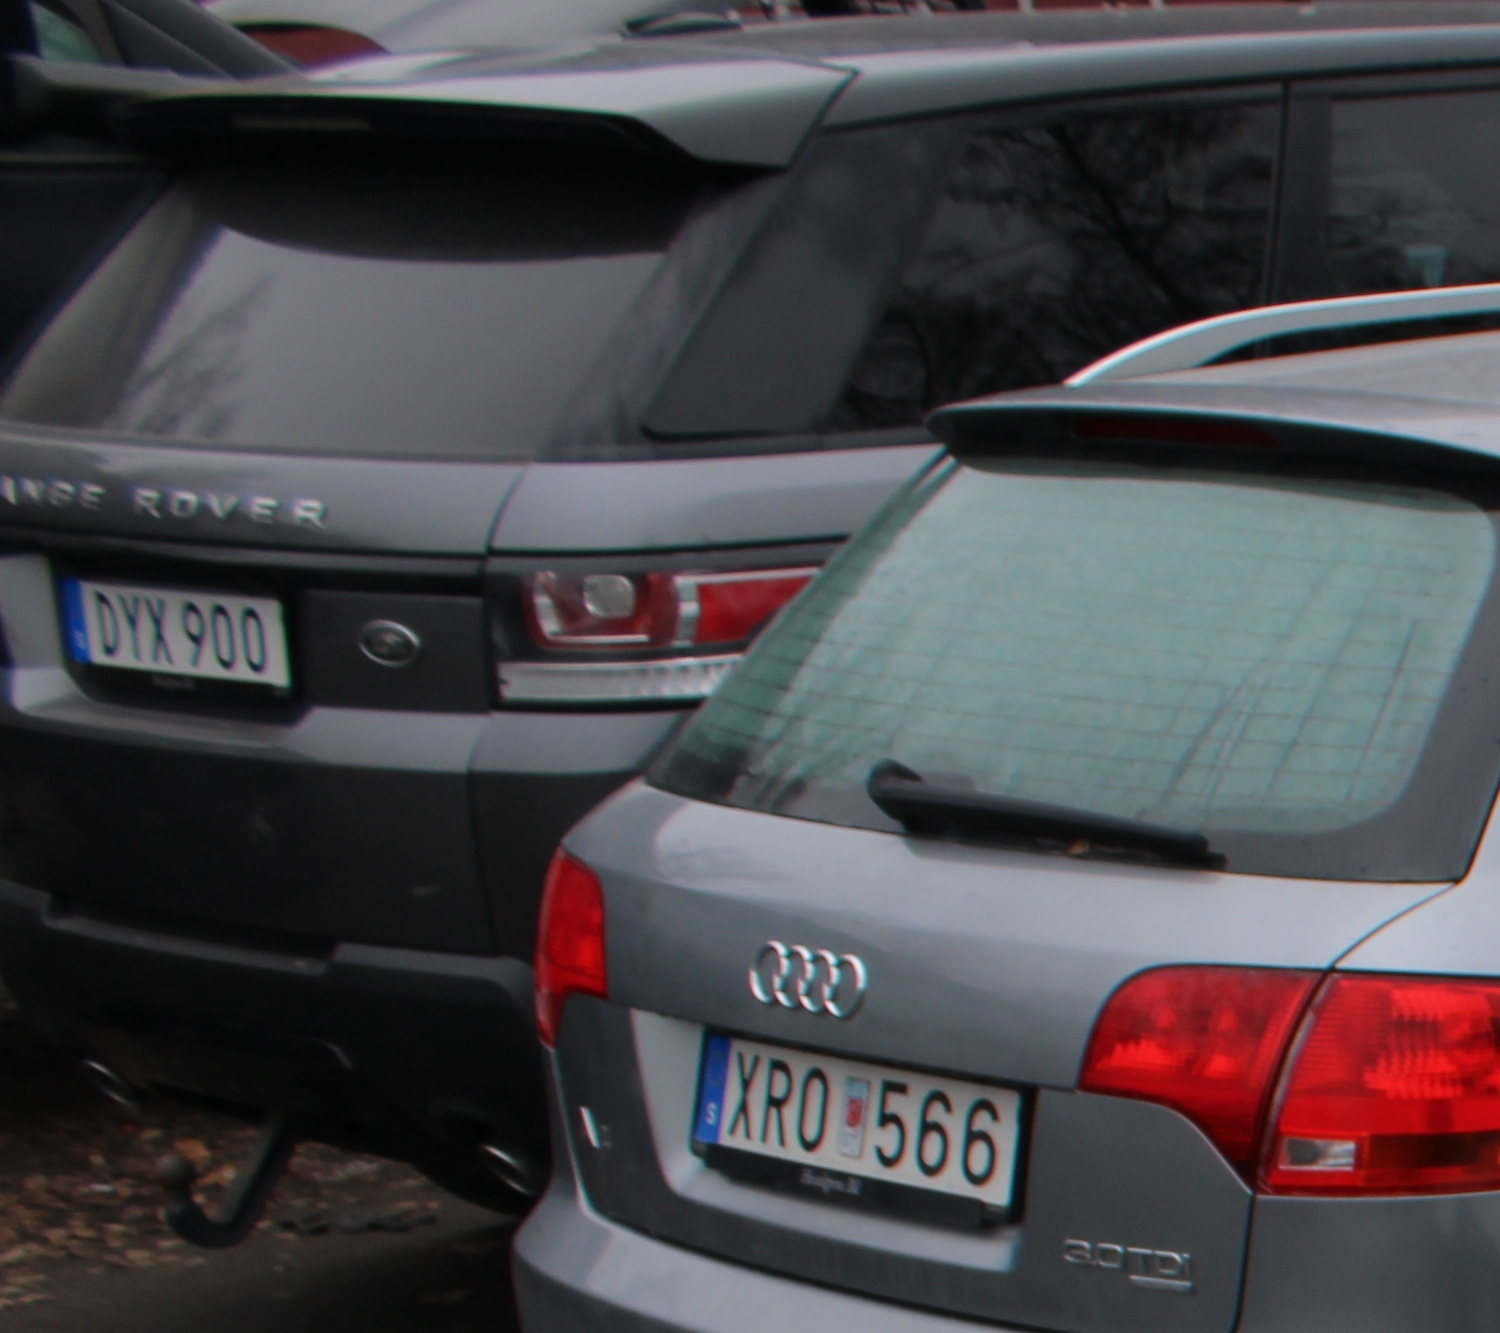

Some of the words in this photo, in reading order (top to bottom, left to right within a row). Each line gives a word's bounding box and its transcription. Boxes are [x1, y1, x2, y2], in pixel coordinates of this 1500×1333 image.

[133, 487, 327, 527] ROVER
[95, 590, 173, 665] DYX
[181, 600, 267, 673] 900
[727, 1050, 830, 1153] XRO
[873, 1078, 1000, 1187] 566
